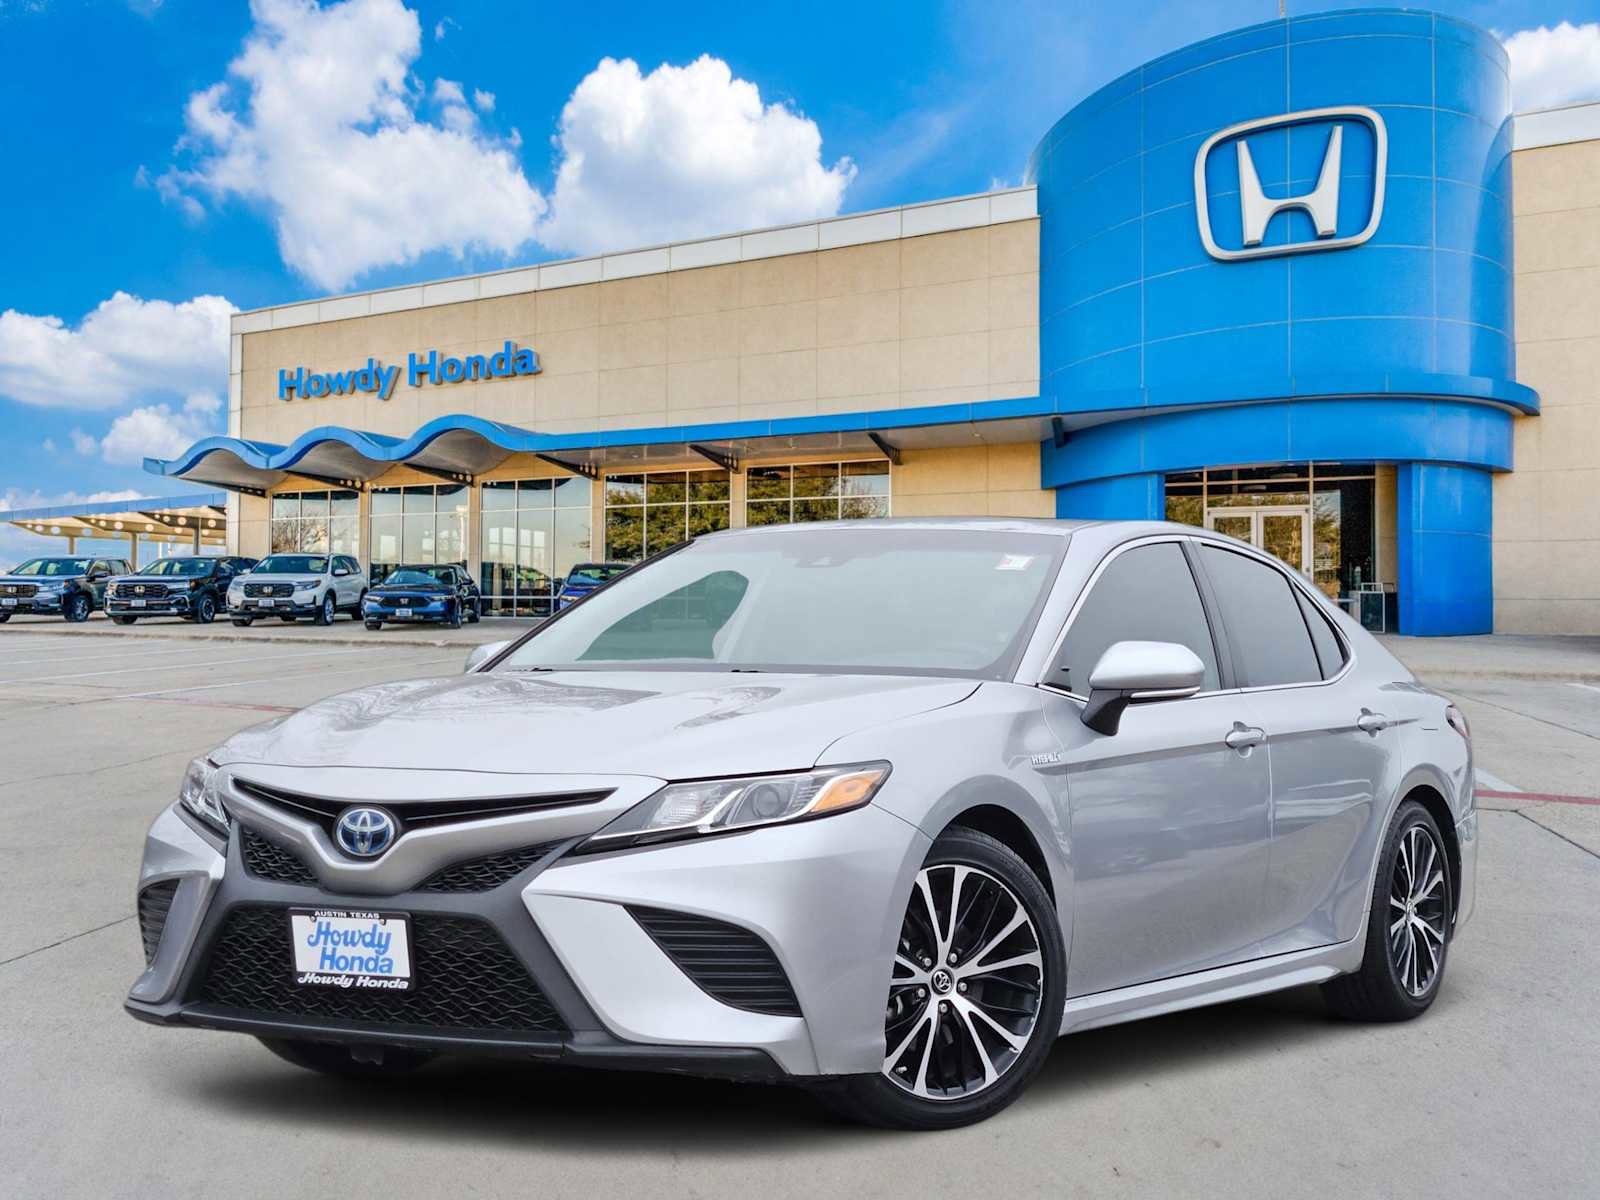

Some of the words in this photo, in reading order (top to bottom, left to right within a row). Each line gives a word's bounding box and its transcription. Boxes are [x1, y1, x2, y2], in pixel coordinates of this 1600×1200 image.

[278, 358, 401, 401] Howdy
[407, 340, 543, 388] Honda
[314, 910, 347, 918] AUSTIN
[349, 911, 380, 919] TEXAS
[307, 921, 392, 955] Howdy
[319, 946, 394, 974] Honda
[297, 972, 354, 988] Howdy
[356, 976, 409, 990] Honda
